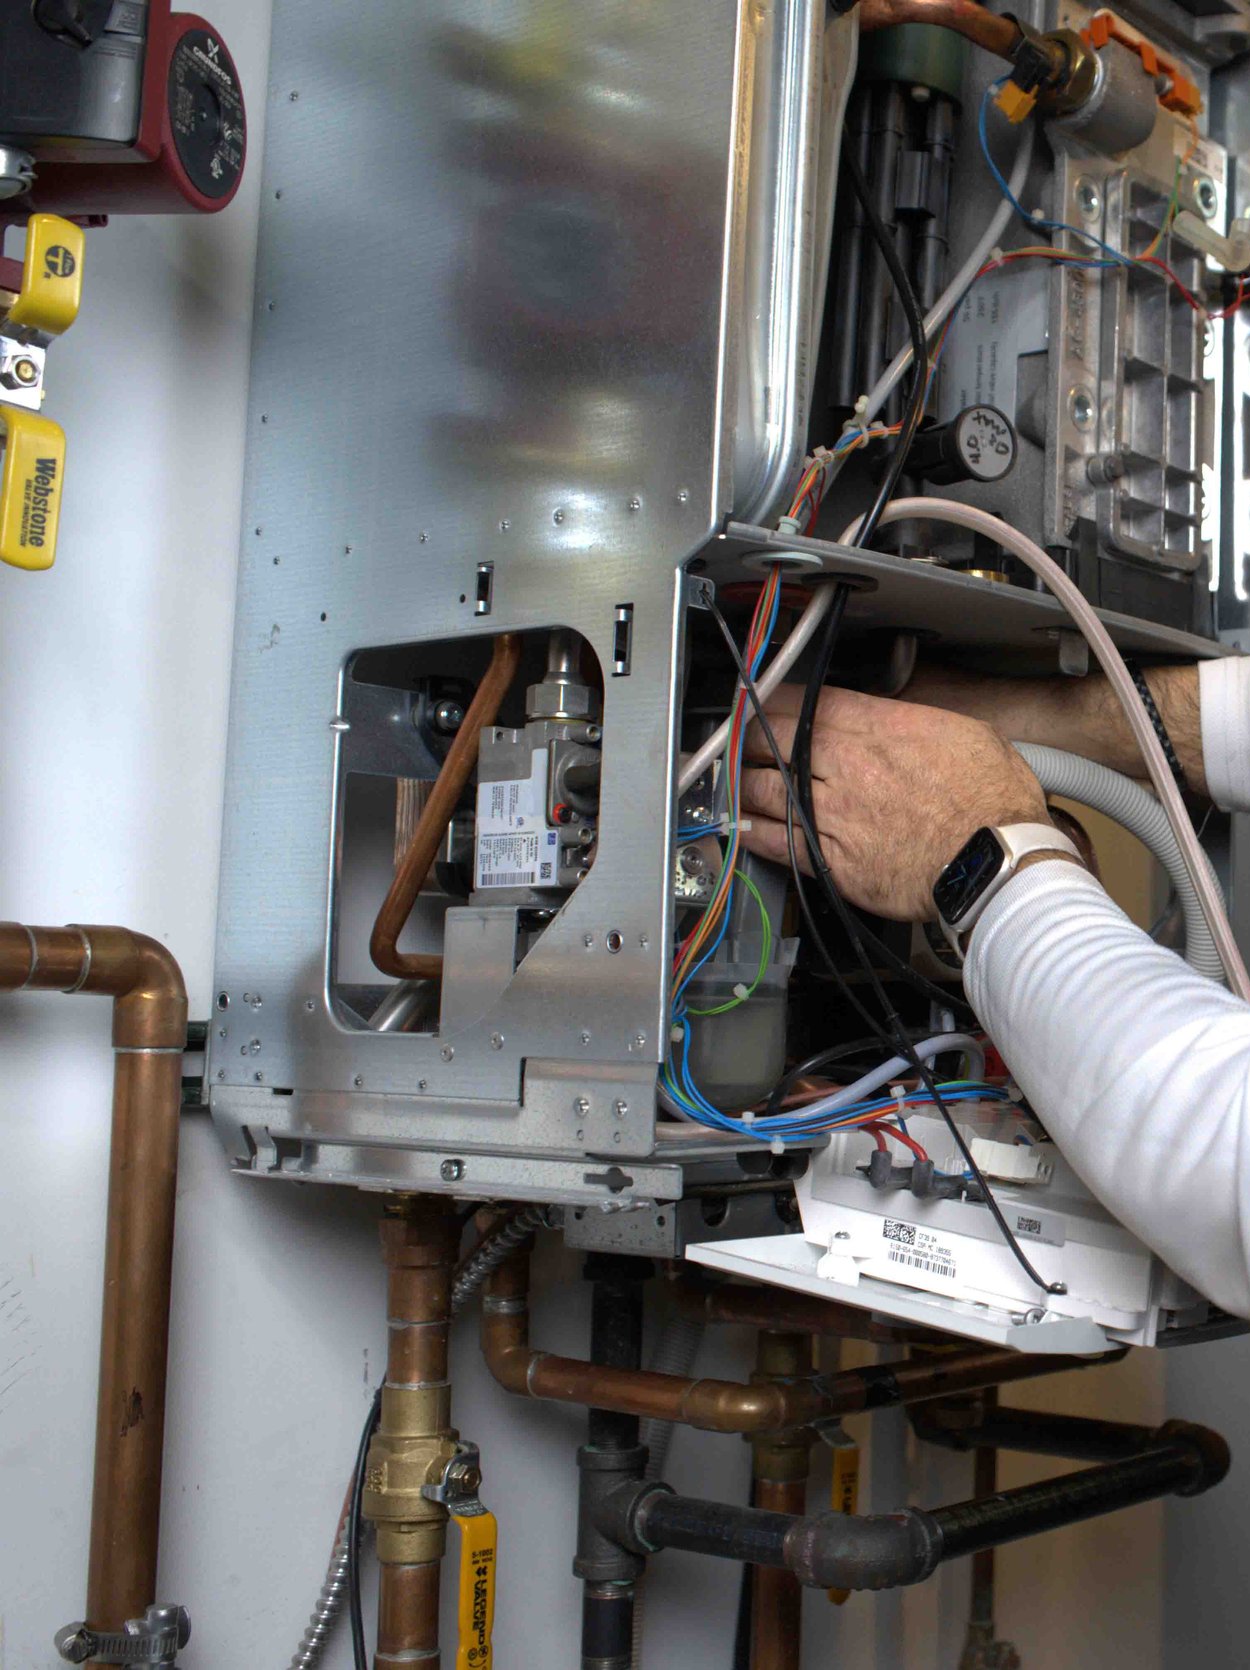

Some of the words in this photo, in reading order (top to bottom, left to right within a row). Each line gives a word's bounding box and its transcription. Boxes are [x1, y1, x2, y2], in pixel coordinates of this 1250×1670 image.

[28, 458, 57, 547] Webstone
[472, 1580, 482, 1631] VALVE
[477, 1579, 489, 1645] LEGEND
